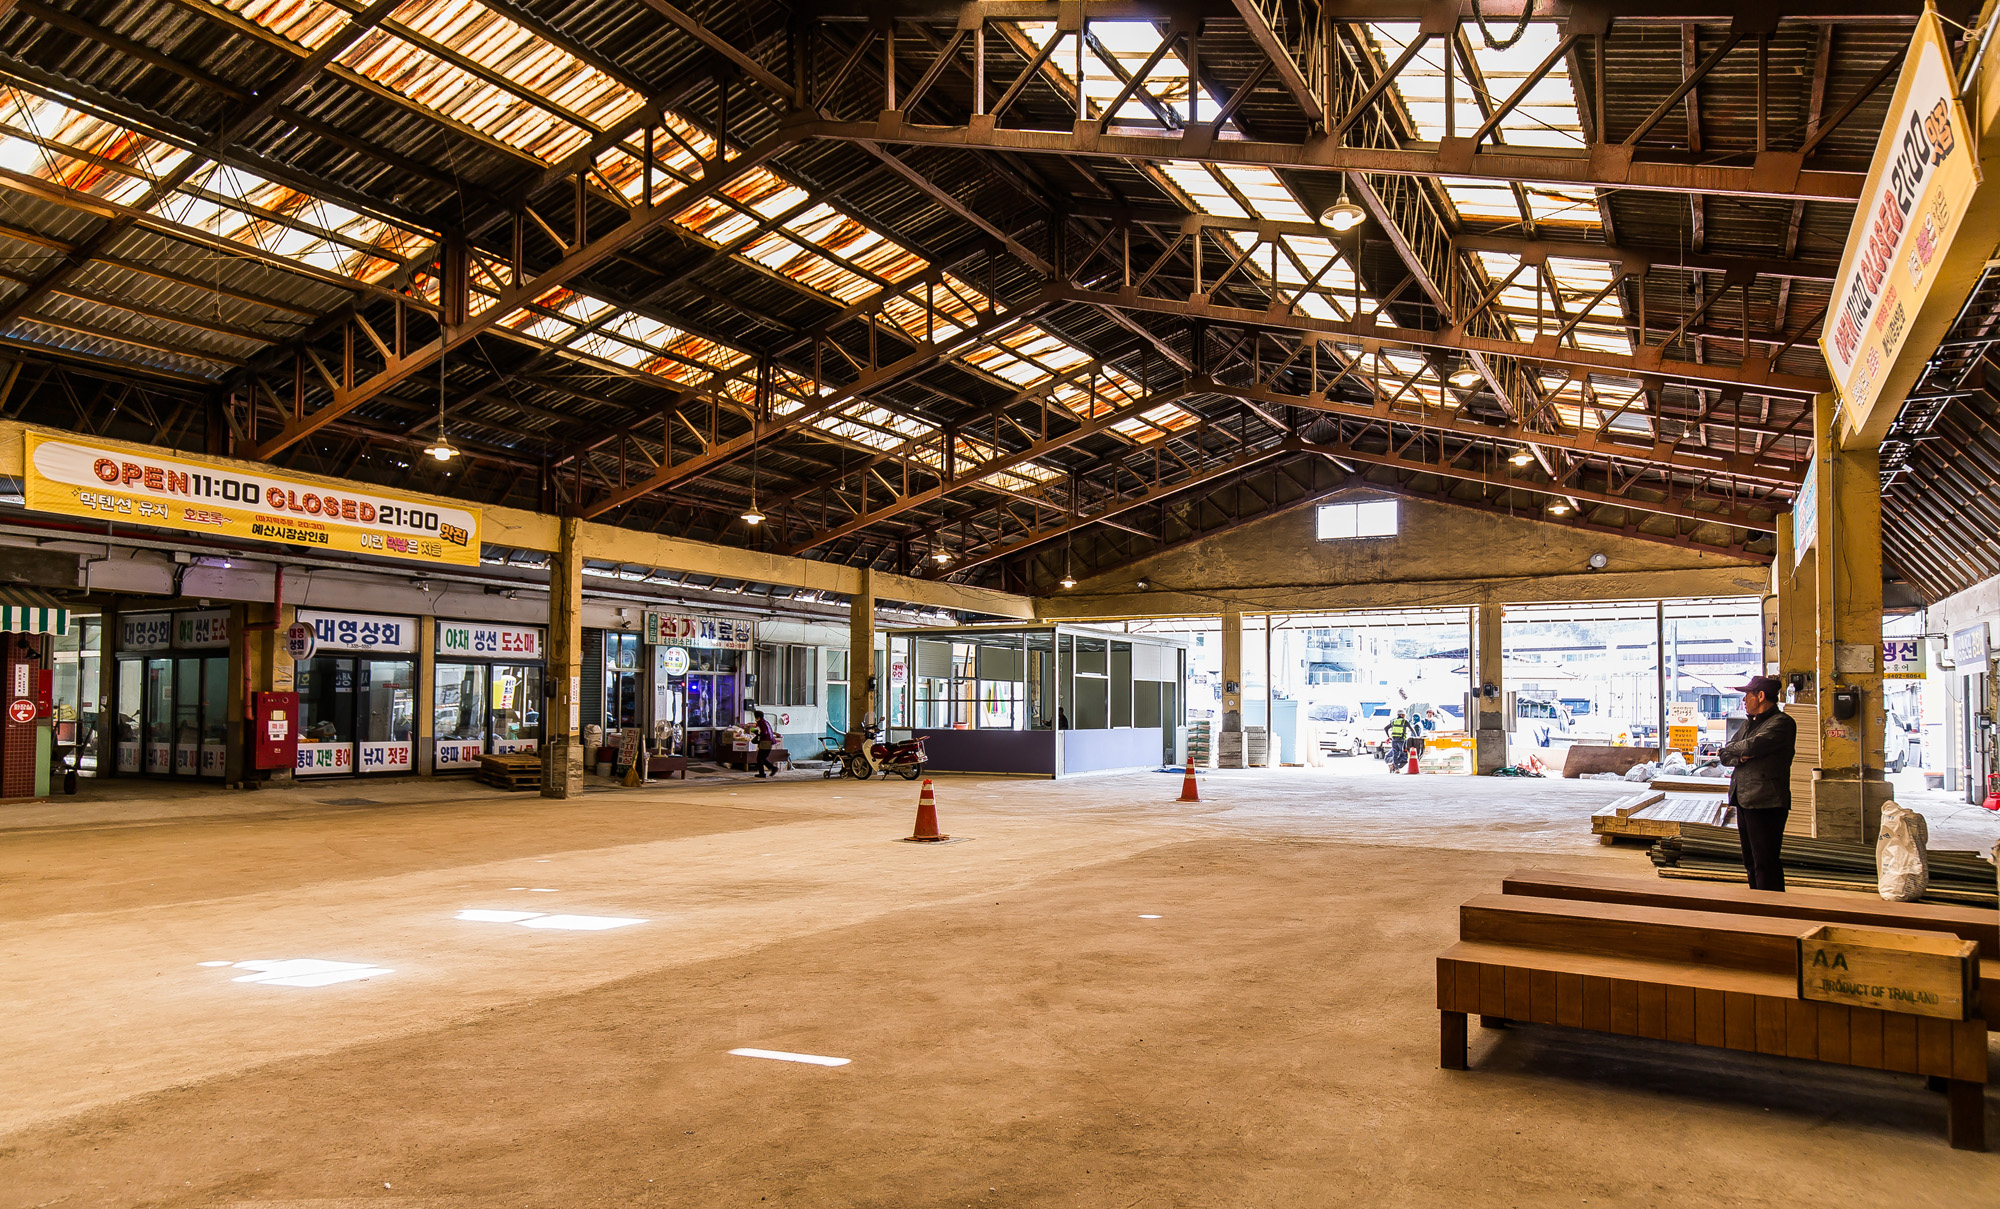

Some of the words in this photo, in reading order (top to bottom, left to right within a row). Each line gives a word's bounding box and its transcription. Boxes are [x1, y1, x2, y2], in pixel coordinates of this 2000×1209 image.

[1925, 97, 1954, 168] 맛집
[1892, 109, 1930, 216] 21:00
[1861, 189, 1906, 296] CLOSED
[1846, 272, 1872, 332] 11:00
[1834, 307, 1861, 366] OPEN
[79, 491, 132, 514] 먹텐션
[139, 501, 169, 519] 유지
[94, 458, 191, 495] OPEN
[192, 474, 260, 504] 11:00
[266, 487, 376, 523] CLOSED
[379, 505, 438, 530] 21:00
[252, 524, 329, 544] 예산시장상인회
[360, 533, 383, 549] 이런
[386, 534, 418, 554] 먹방은
[420, 541, 442, 557] 처음
[440, 522, 468, 546] 맛집
[125, 621, 170, 645] 대영상회
[196, 618, 209, 643] 생선
[289, 628, 304, 639] 대영
[315, 619, 400, 646] 대영상회
[446, 628, 469, 650] 야채
[474, 630, 497, 652] 생선
[502, 632, 535, 653] 도소매
[660, 616, 696, 638] 전기
[700, 619, 750, 643] 재료상
[289, 640, 305, 651] 상회
[1883, 642, 1918, 662] 생선
[298, 750, 313, 769] 동태
[316, 749, 332, 767] 자반
[335, 748, 351, 767] 홍어
[388, 747, 408, 765] 젓갈
[441, 746, 460, 763] 양파
[1822, 979, 1868, 996] PRODUCT
[1871, 984, 1885, 998] OF
